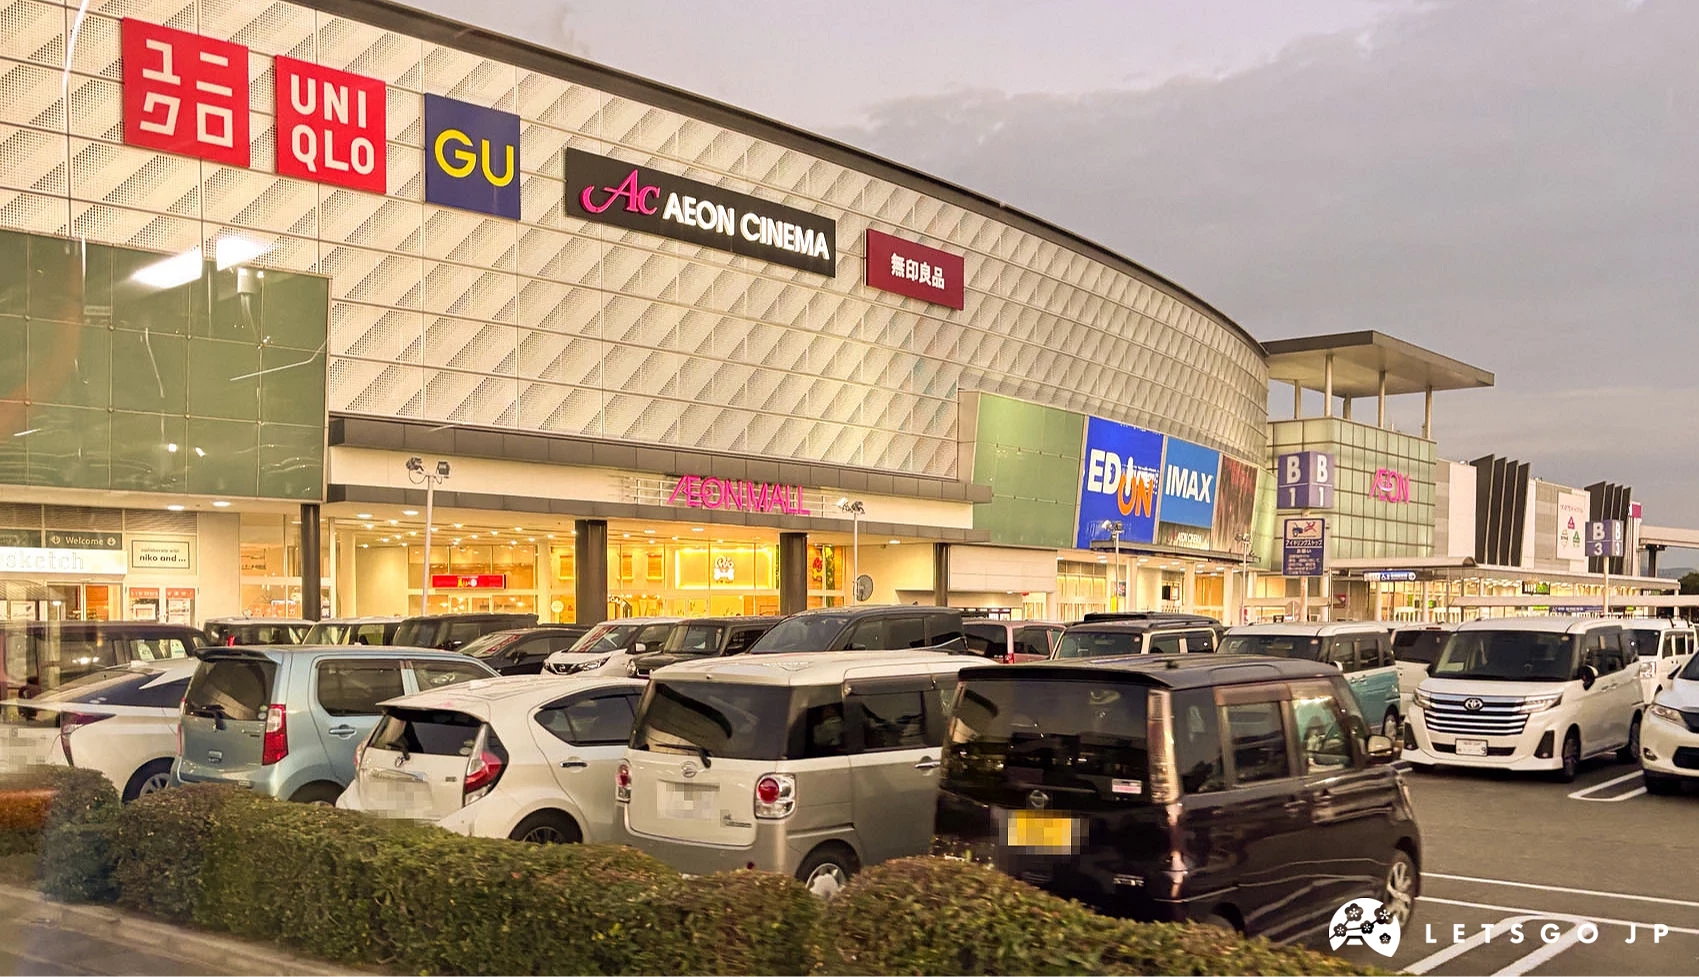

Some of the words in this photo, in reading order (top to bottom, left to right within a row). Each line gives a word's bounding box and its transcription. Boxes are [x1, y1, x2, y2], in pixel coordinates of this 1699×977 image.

[142, 38, 233, 97] ユニ
[290, 73, 367, 129] UNI
[140, 91, 234, 149] クロ
[291, 124, 375, 175] QLO
[435, 129, 515, 187] GU
[662, 192, 735, 237] AEON
[739, 212, 830, 261] CINEMA
[890, 252, 945, 290] 無印良品
[1165, 464, 1214, 504] IMAX
[1287, 455, 1301, 484] B
[1316, 454, 1328, 483] B
[746, 480, 811, 516] MALL
[1289, 487, 1296, 507] 1
[1319, 486, 1325, 507] 1
[65, 536, 104, 546] Welcome
[1593, 522, 1605, 540] B
[1615, 521, 1621, 539] B
[160, 554, 177, 562] and
[1594, 542, 1603, 556] 3
